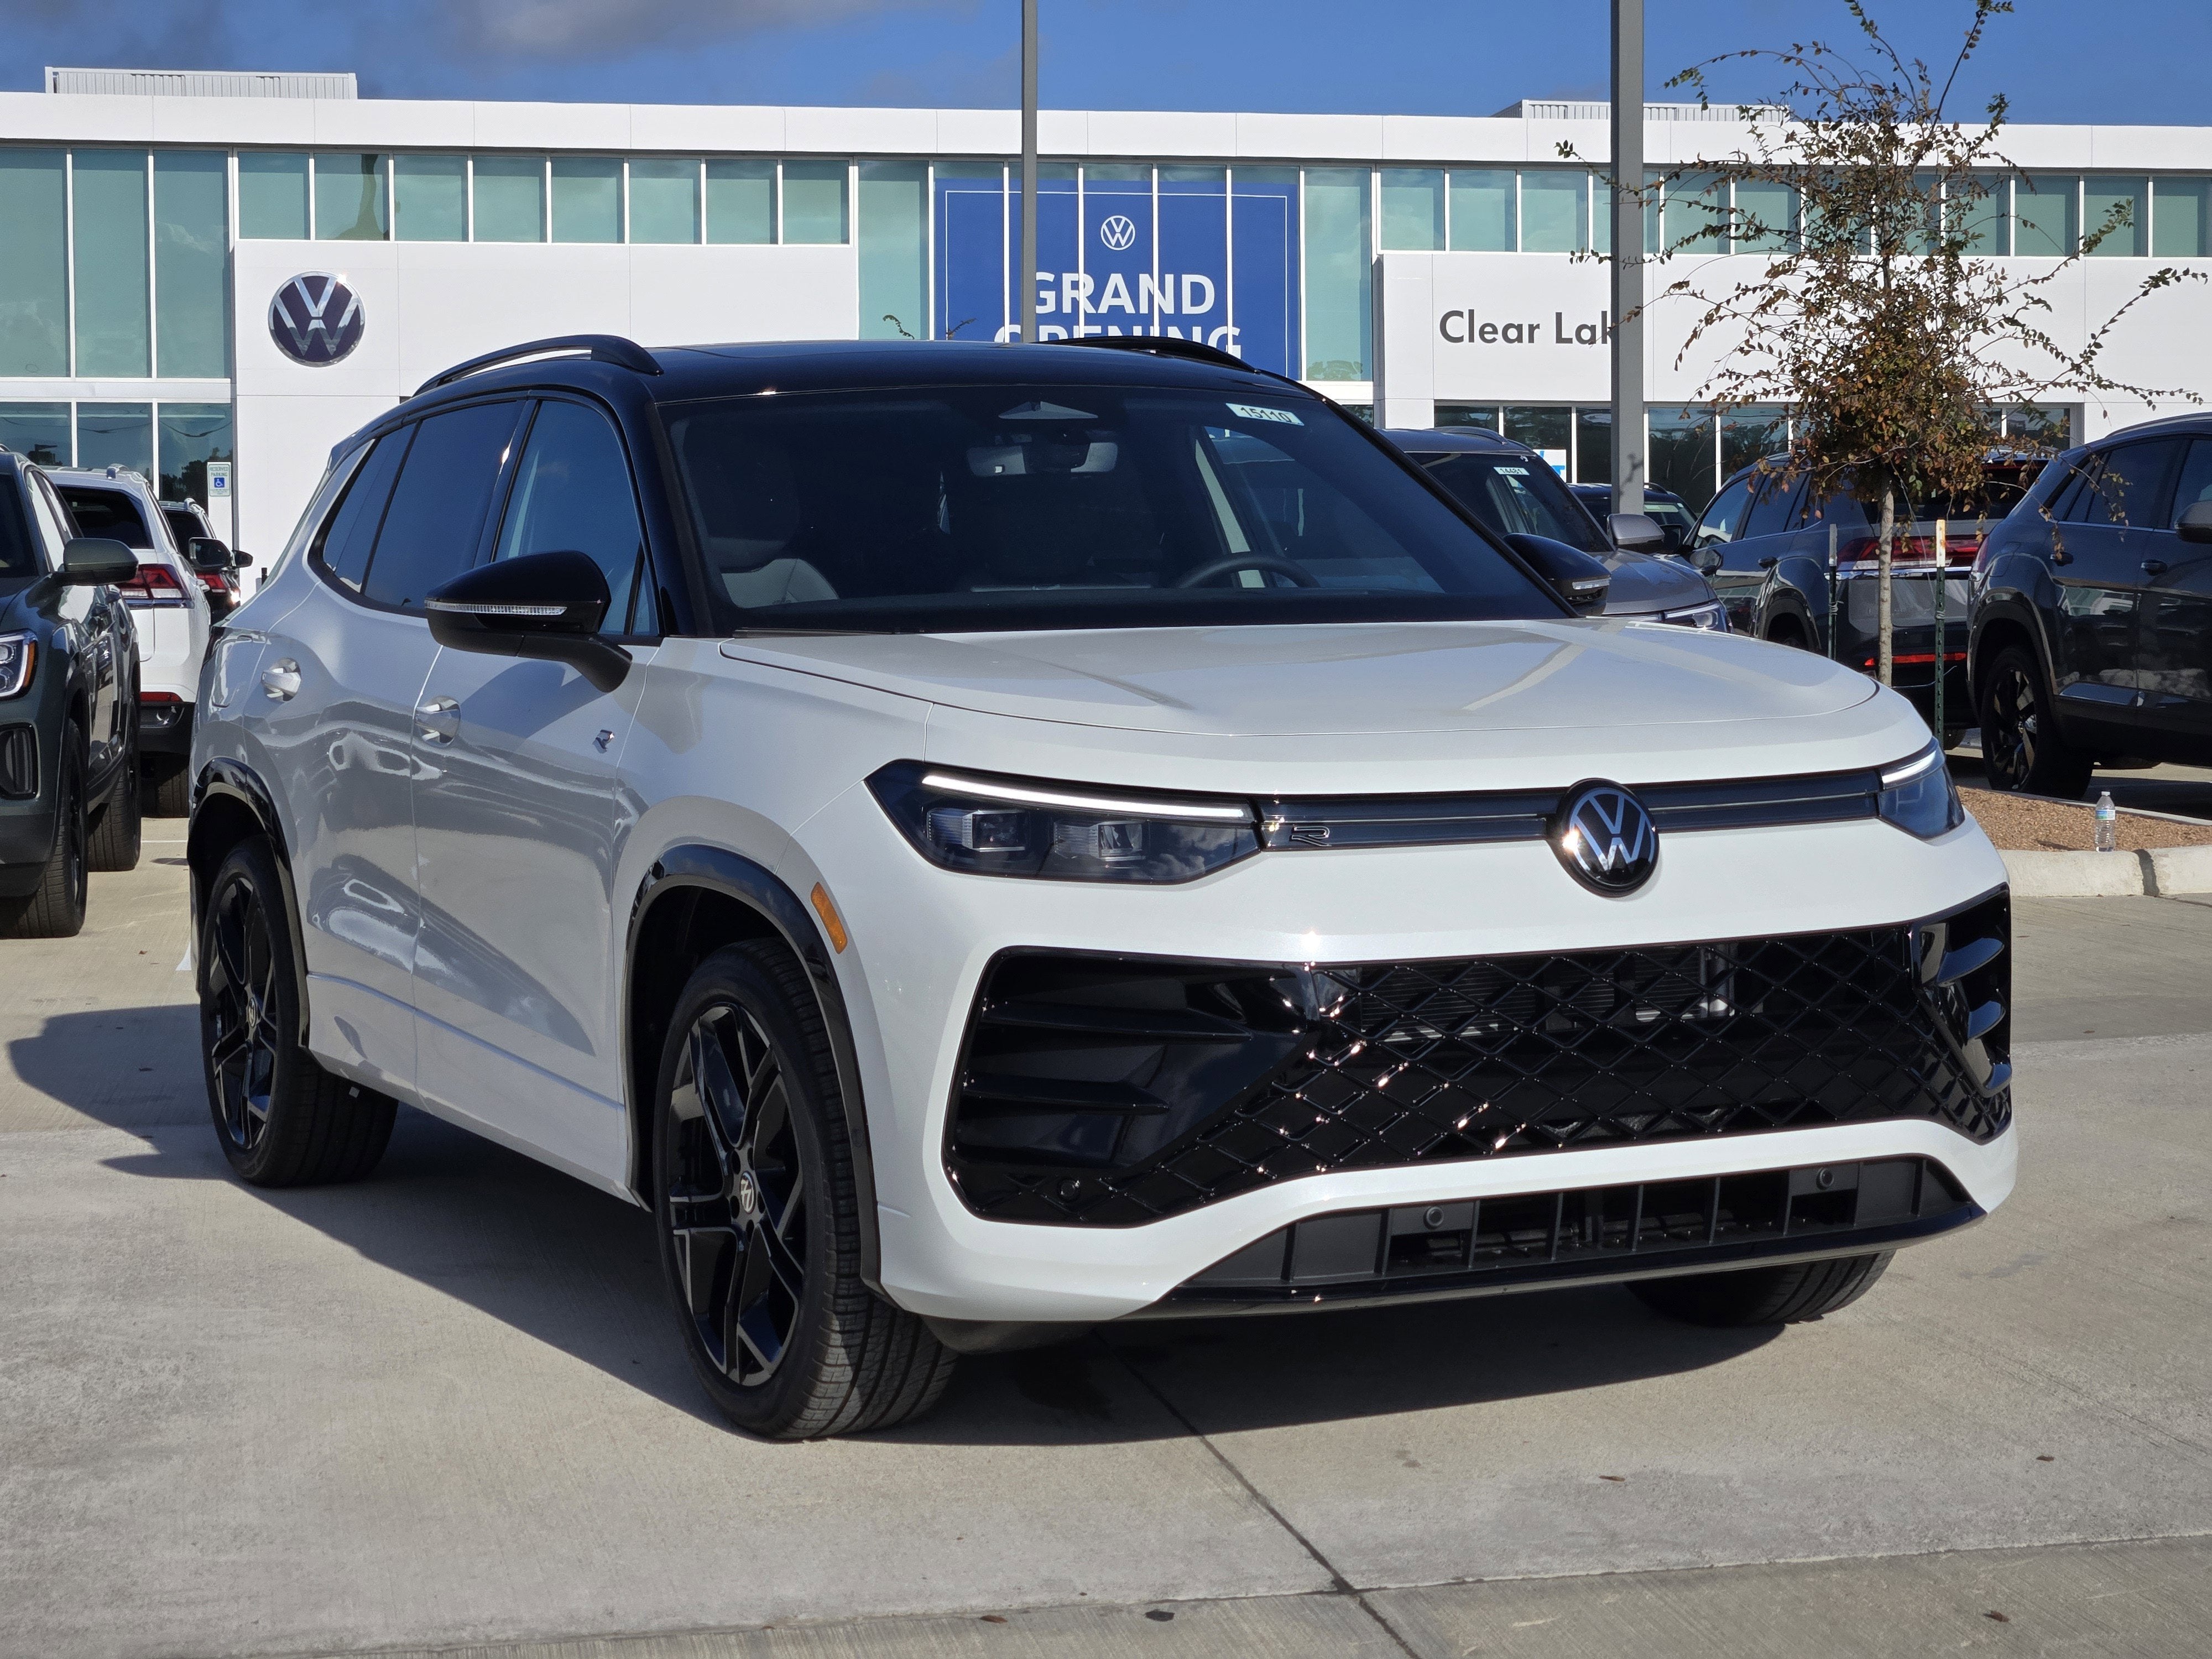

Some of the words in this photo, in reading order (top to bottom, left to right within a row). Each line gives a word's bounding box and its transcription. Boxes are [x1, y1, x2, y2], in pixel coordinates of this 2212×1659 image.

[1100, 215, 1135, 251] VW
[1036, 272, 1215, 314] GRAND
[268, 270, 366, 367] VW
[1439, 309, 1540, 343] Clear
[1555, 310, 1611, 345] Lak
[1240, 407, 1292, 422] 15110
[1569, 787, 1655, 886] VW
